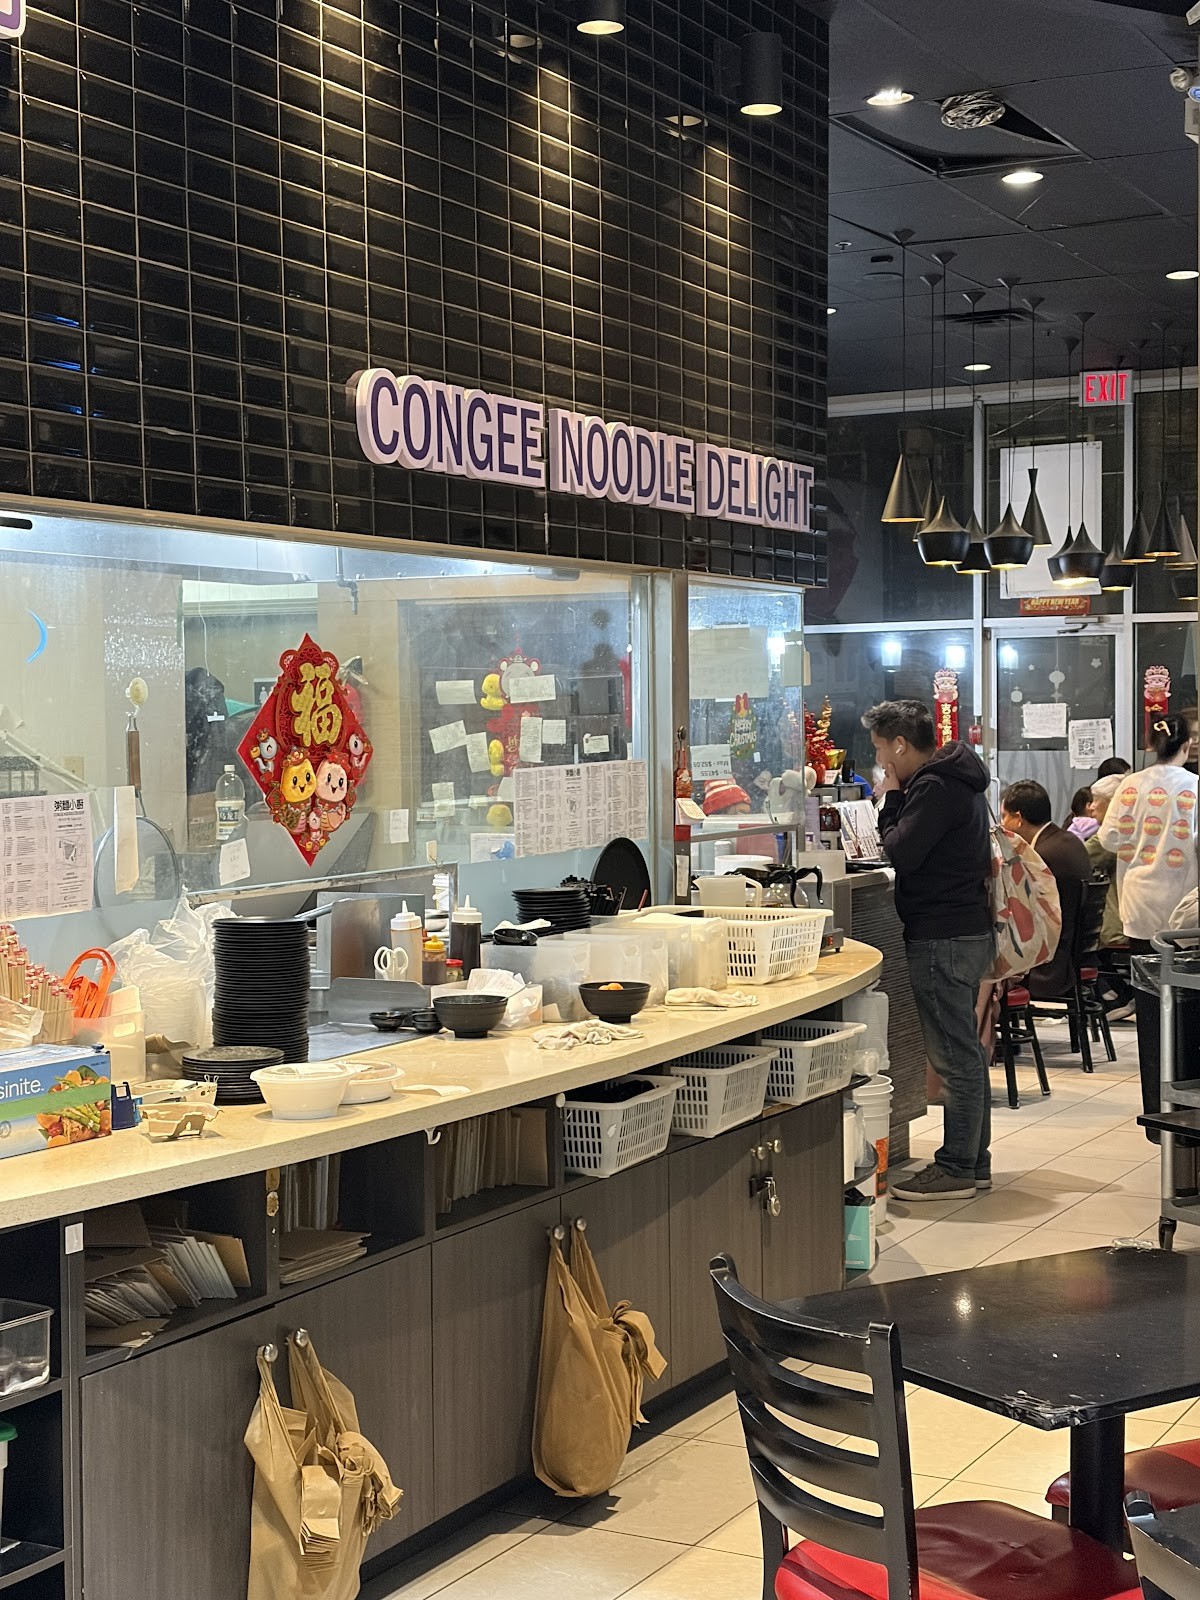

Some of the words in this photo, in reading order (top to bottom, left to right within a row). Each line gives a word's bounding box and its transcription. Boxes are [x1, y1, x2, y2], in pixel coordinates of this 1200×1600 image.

[1085, 374, 1128, 402] EXIT
[370, 376, 542, 479] CONGEE
[561, 417, 692, 506] NOODLE
[707, 450, 813, 526] DELIGHT
[291, 662, 343, 748] 福
[735, 718, 752, 732] MERRY
[729, 731, 757, 748] CHRISTMAS
